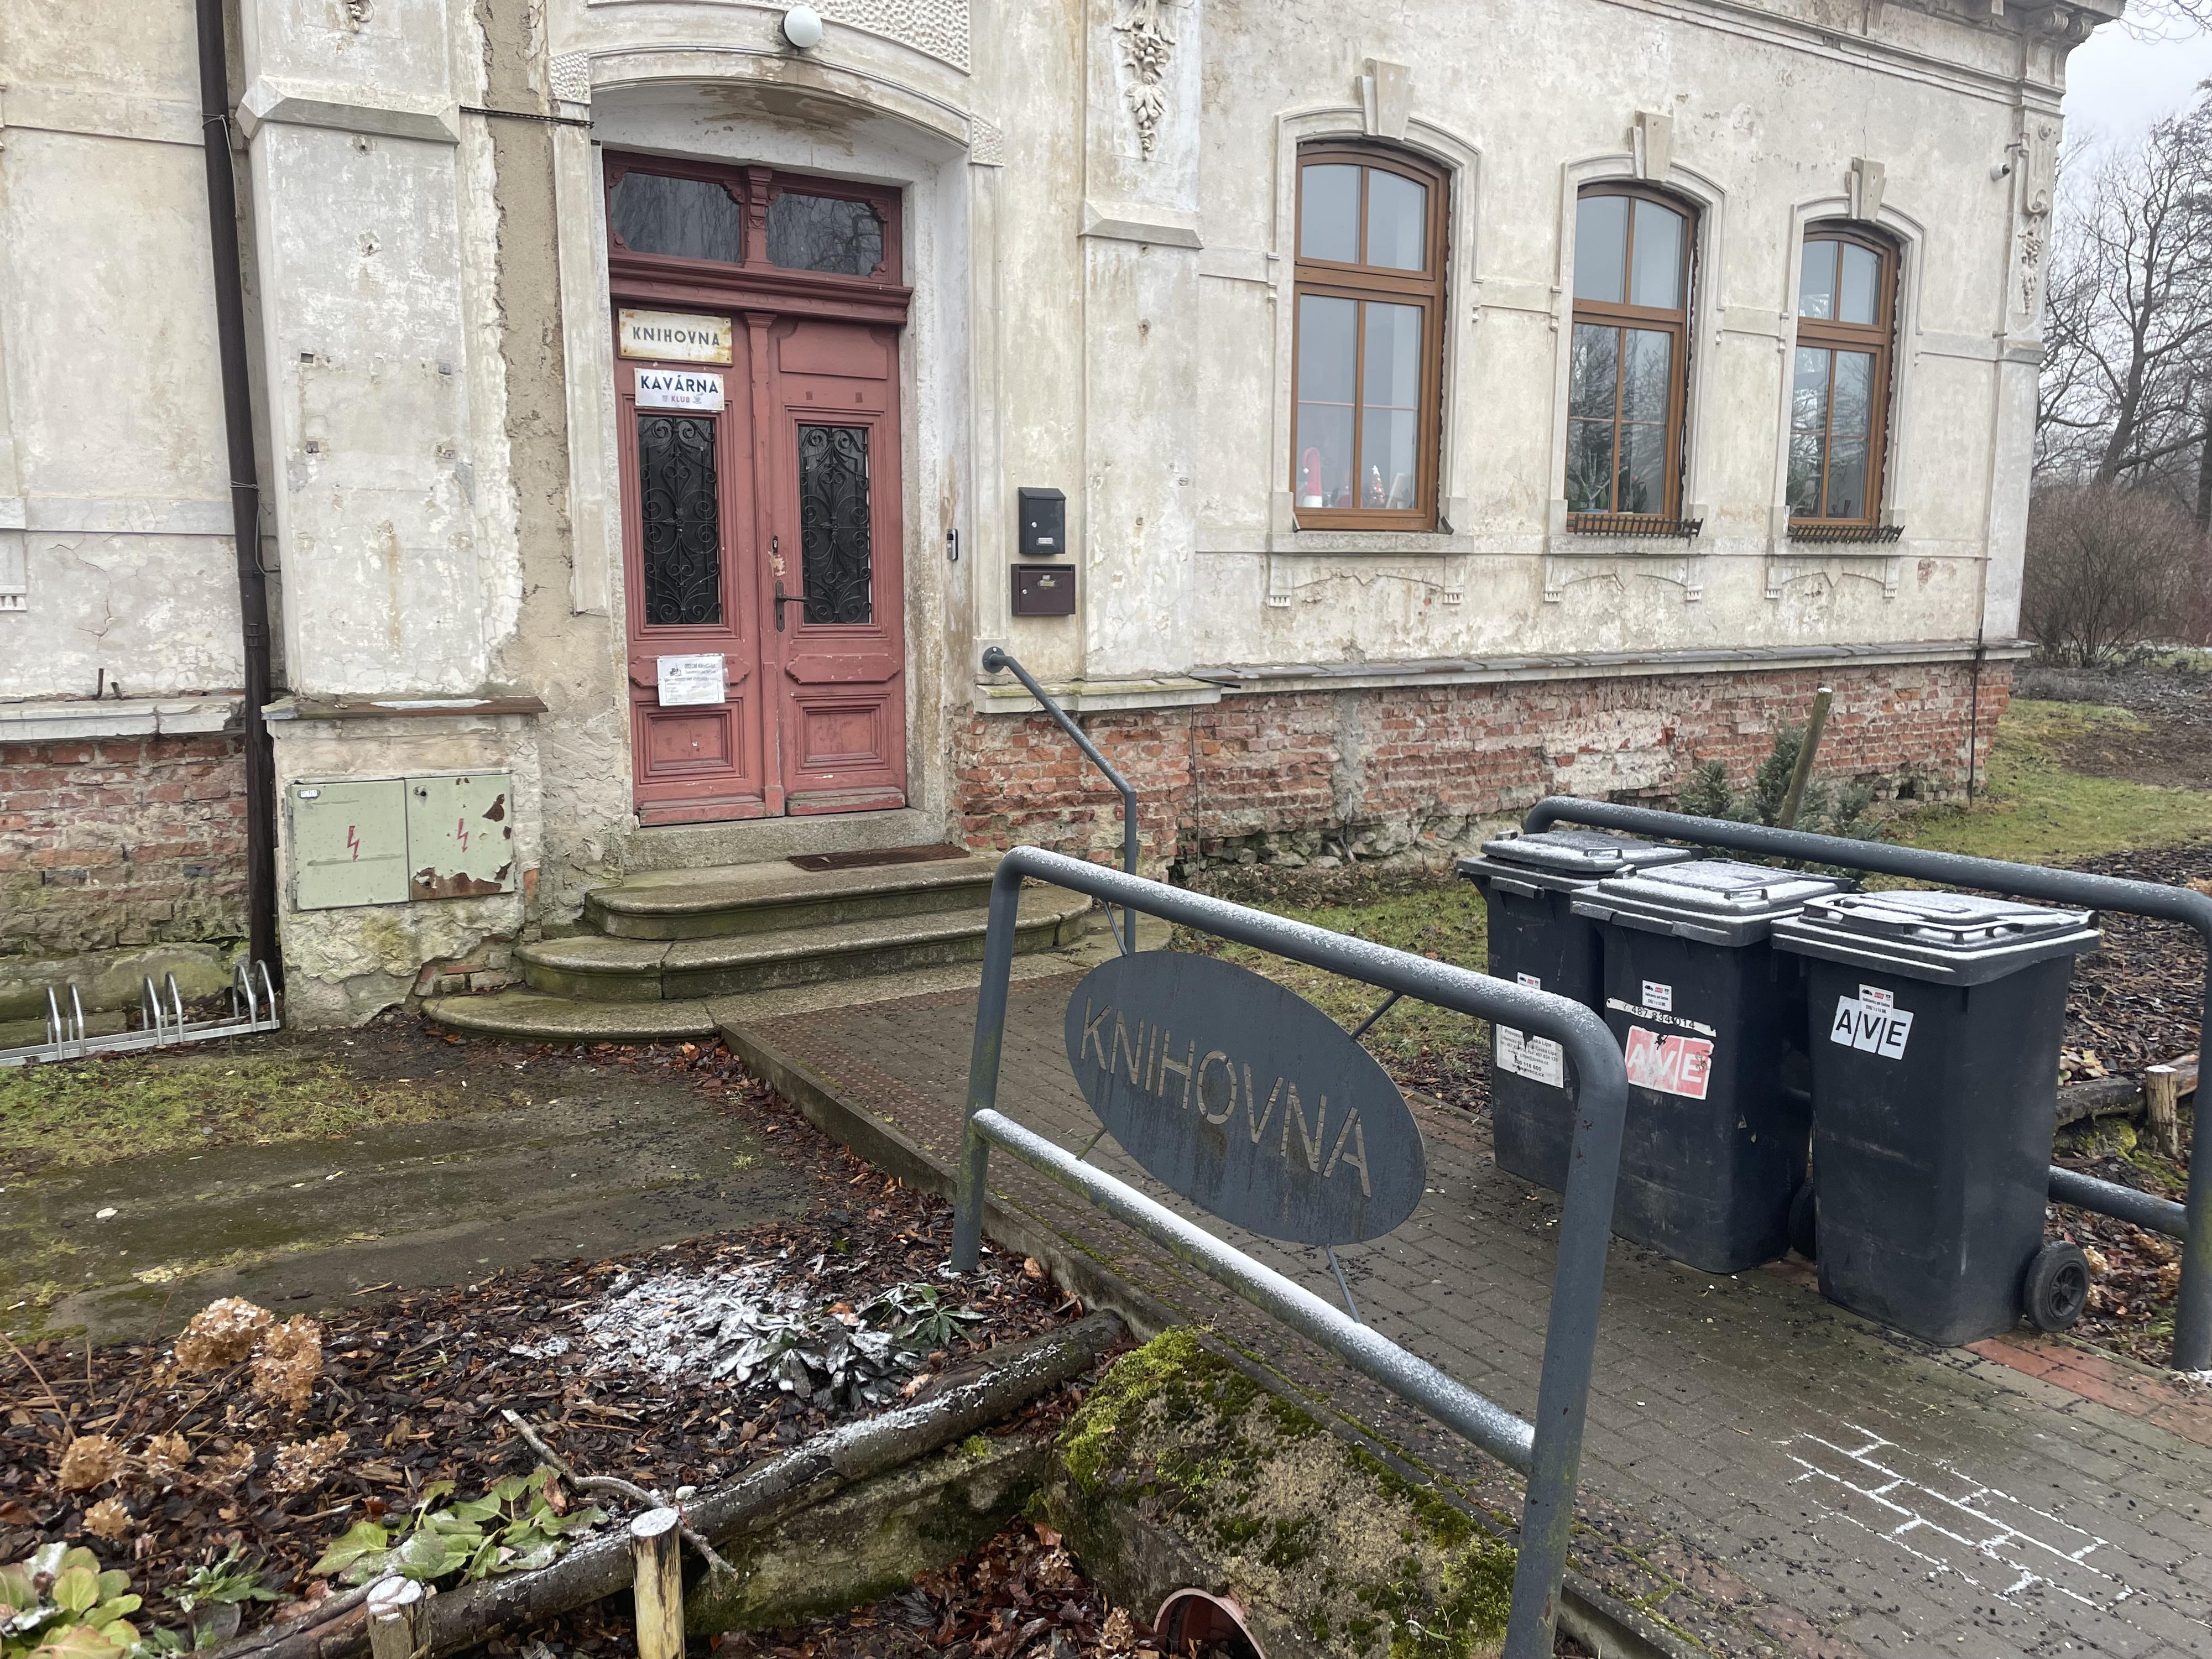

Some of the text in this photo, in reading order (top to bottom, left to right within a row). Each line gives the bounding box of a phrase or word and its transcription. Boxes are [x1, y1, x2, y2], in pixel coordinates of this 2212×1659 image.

[633, 326, 720, 346] KNIHOVNA
[640, 375, 718, 394] KAVÁRNA
[671, 395, 690, 403] KLUB
[1631, 1005, 1695, 1029] 487 834 014
[1835, 1009, 1907, 1047] AVE
[1627, 1043, 1705, 1083] AVE
[1080, 997, 1371, 1198] KNIHOVNA
